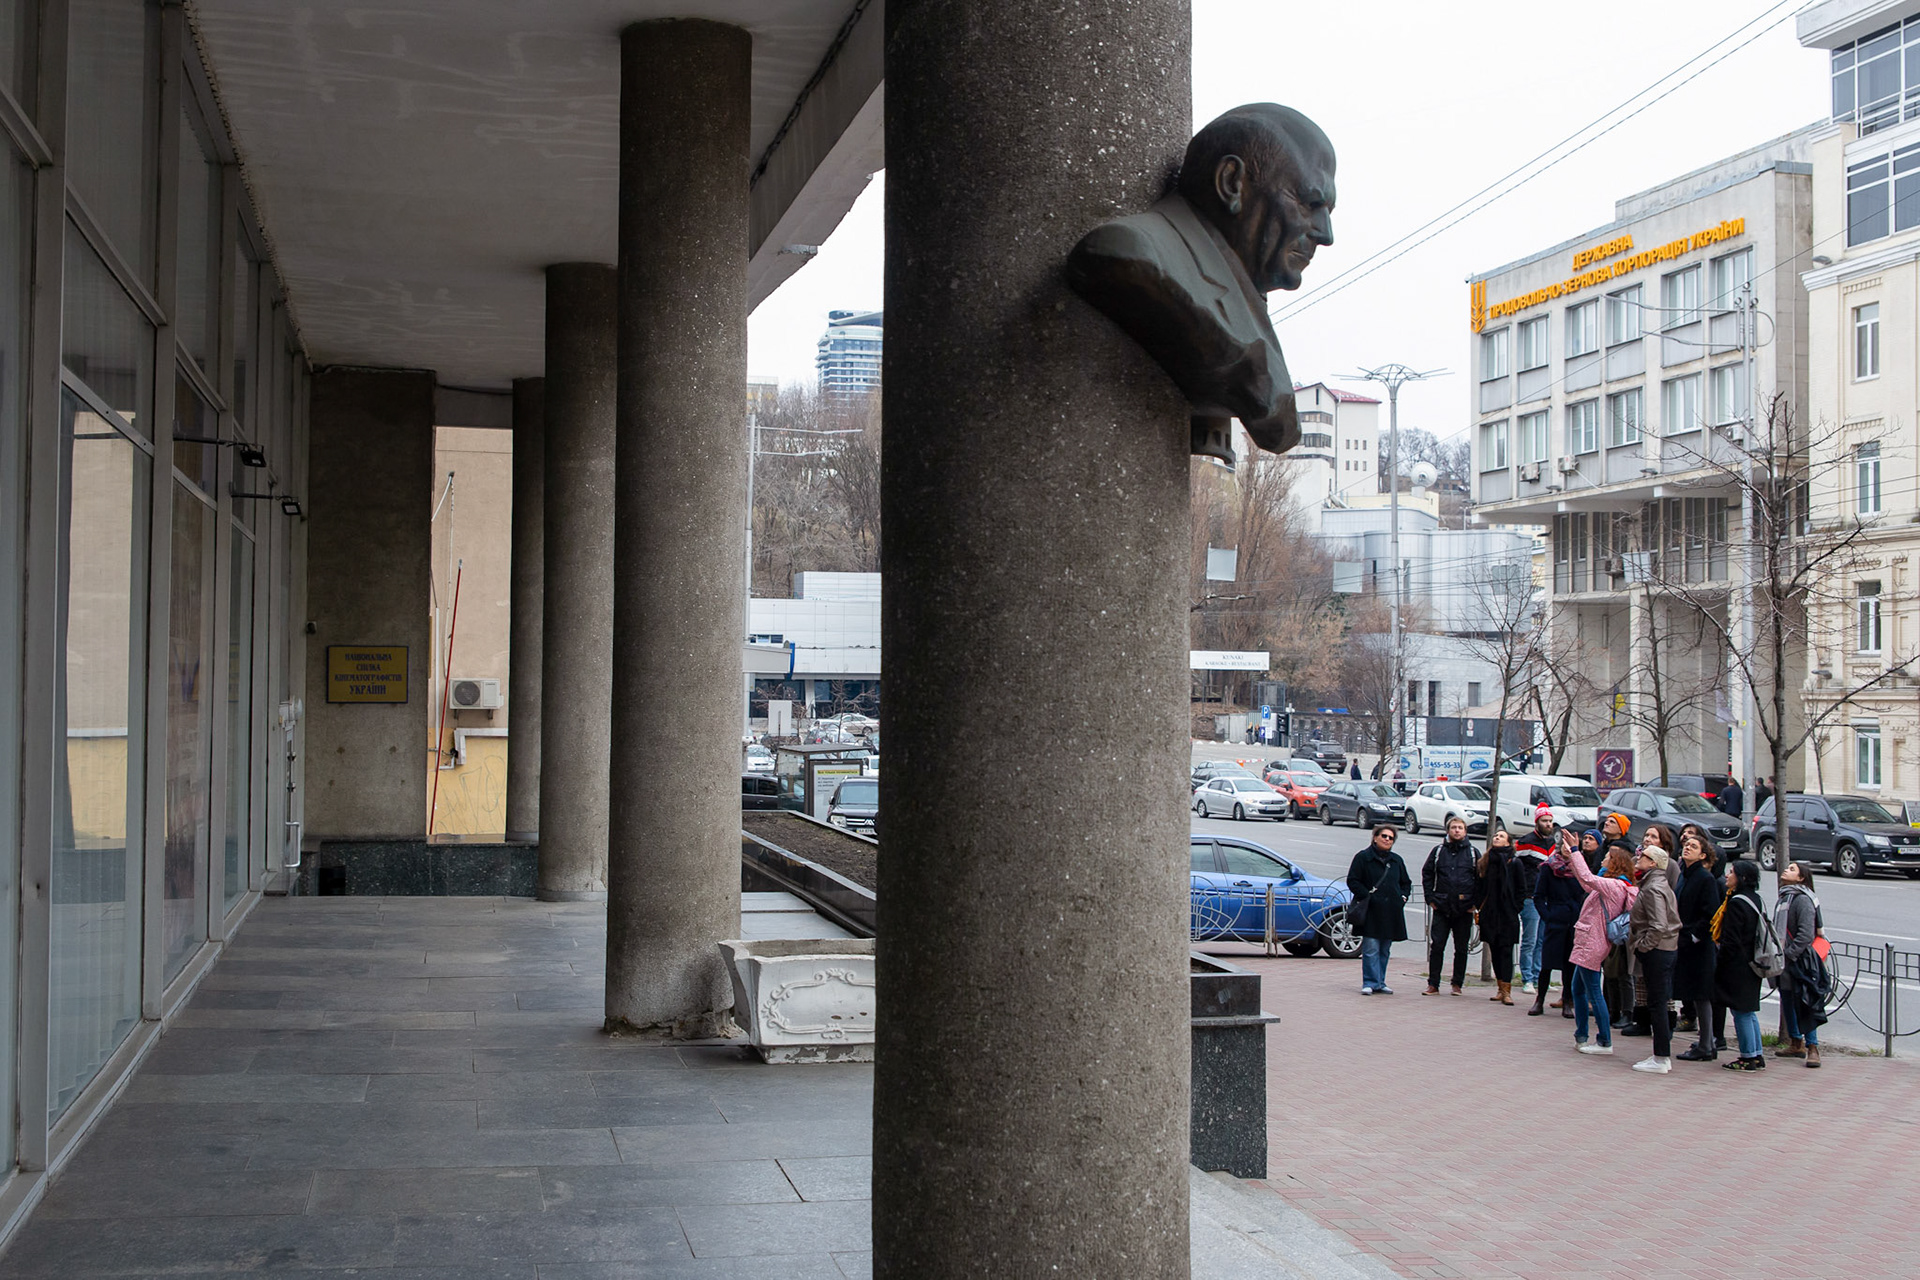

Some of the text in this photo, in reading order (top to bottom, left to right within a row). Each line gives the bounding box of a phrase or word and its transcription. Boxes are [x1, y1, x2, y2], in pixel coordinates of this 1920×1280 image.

[1572, 234, 1634, 272] ДЕРЖАВНА
[1489, 217, 1745, 319] ПРОДОВОЛЬЧО-ЗЕРНОВА КОРПОРАЦІЯ УКРАЇНИ
[344, 653, 393, 661] НАЦІОНАЛЬНА
[356, 663, 382, 671] СПІЛКА
[349, 682, 387, 695] УКРАЇНИ
